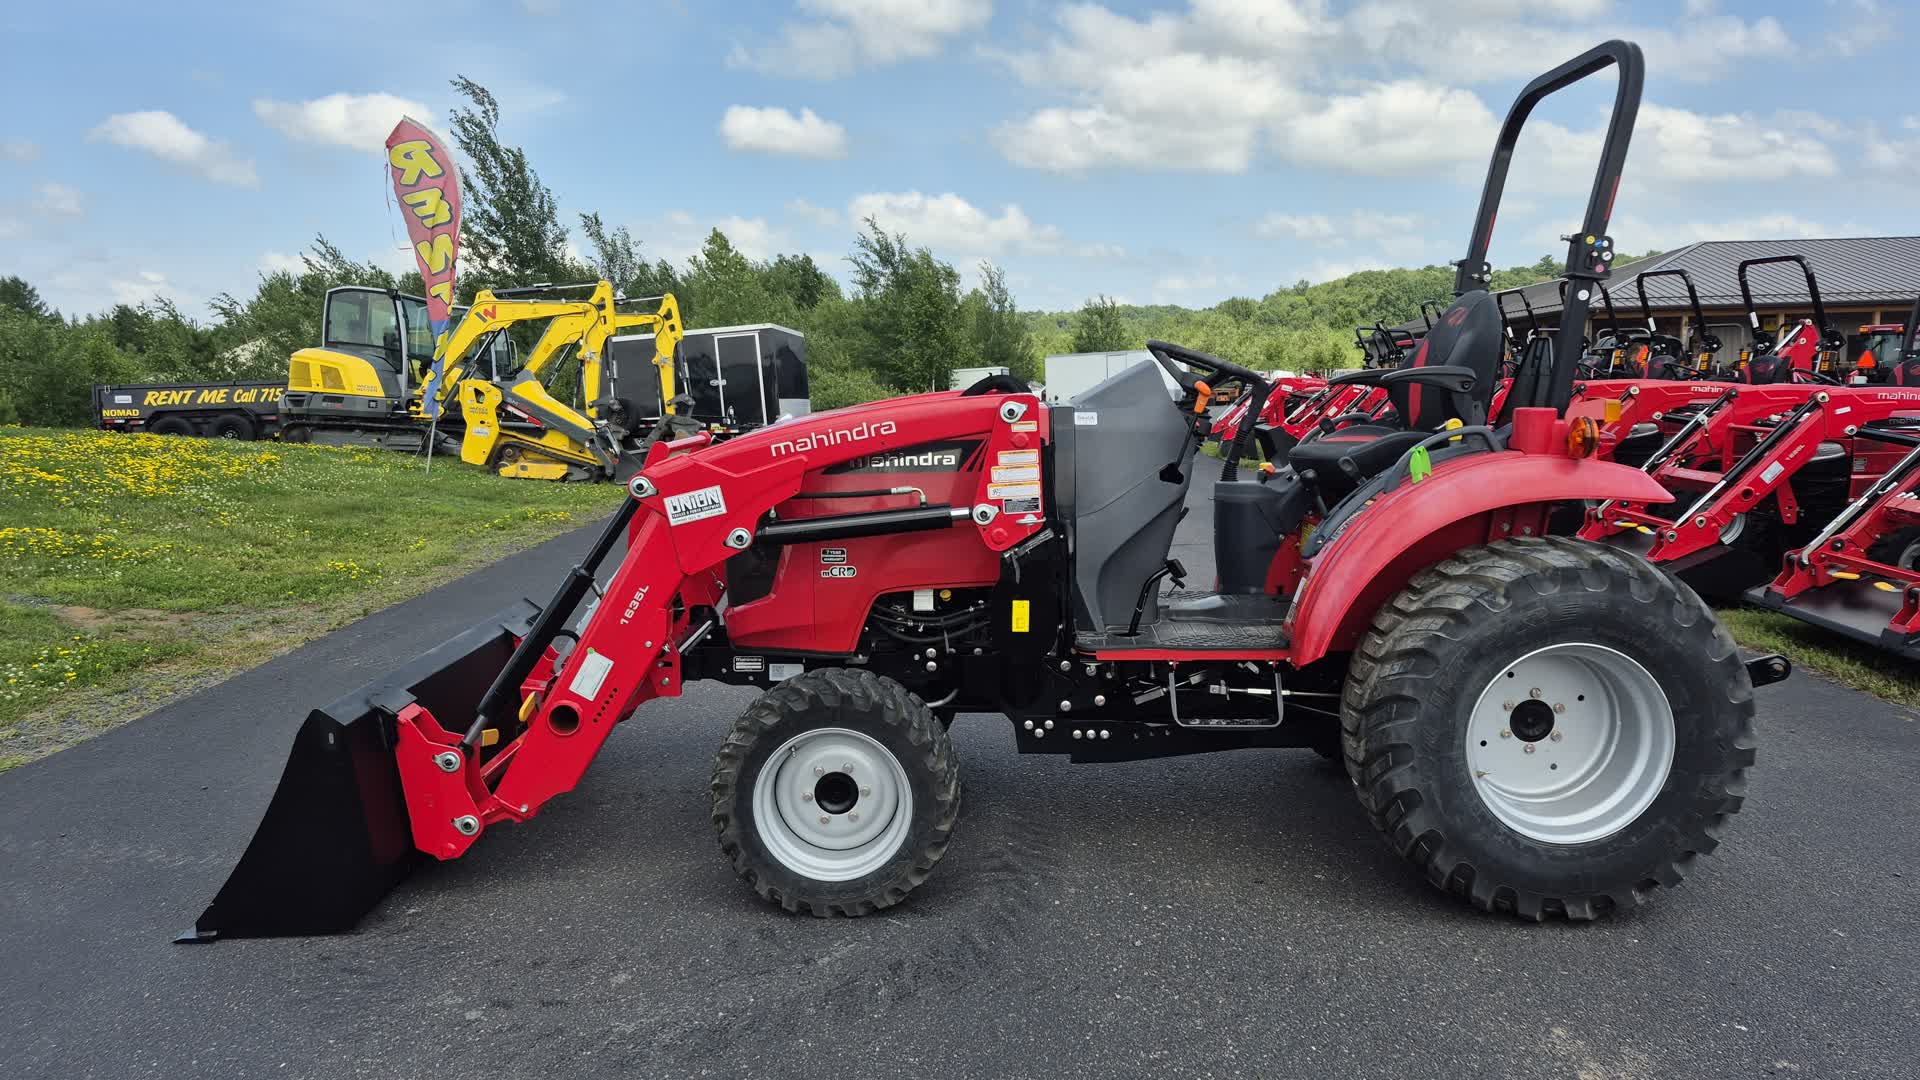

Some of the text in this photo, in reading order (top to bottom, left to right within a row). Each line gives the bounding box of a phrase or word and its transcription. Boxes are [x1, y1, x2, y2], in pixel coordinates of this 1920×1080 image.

[143, 387, 284, 407] RENT ME Call 715
[1878, 392, 1920, 400] mahin
[102, 408, 140, 417] NOMAD
[770, 420, 897, 457] mahindra
[620, 585, 649, 624] 1635L
